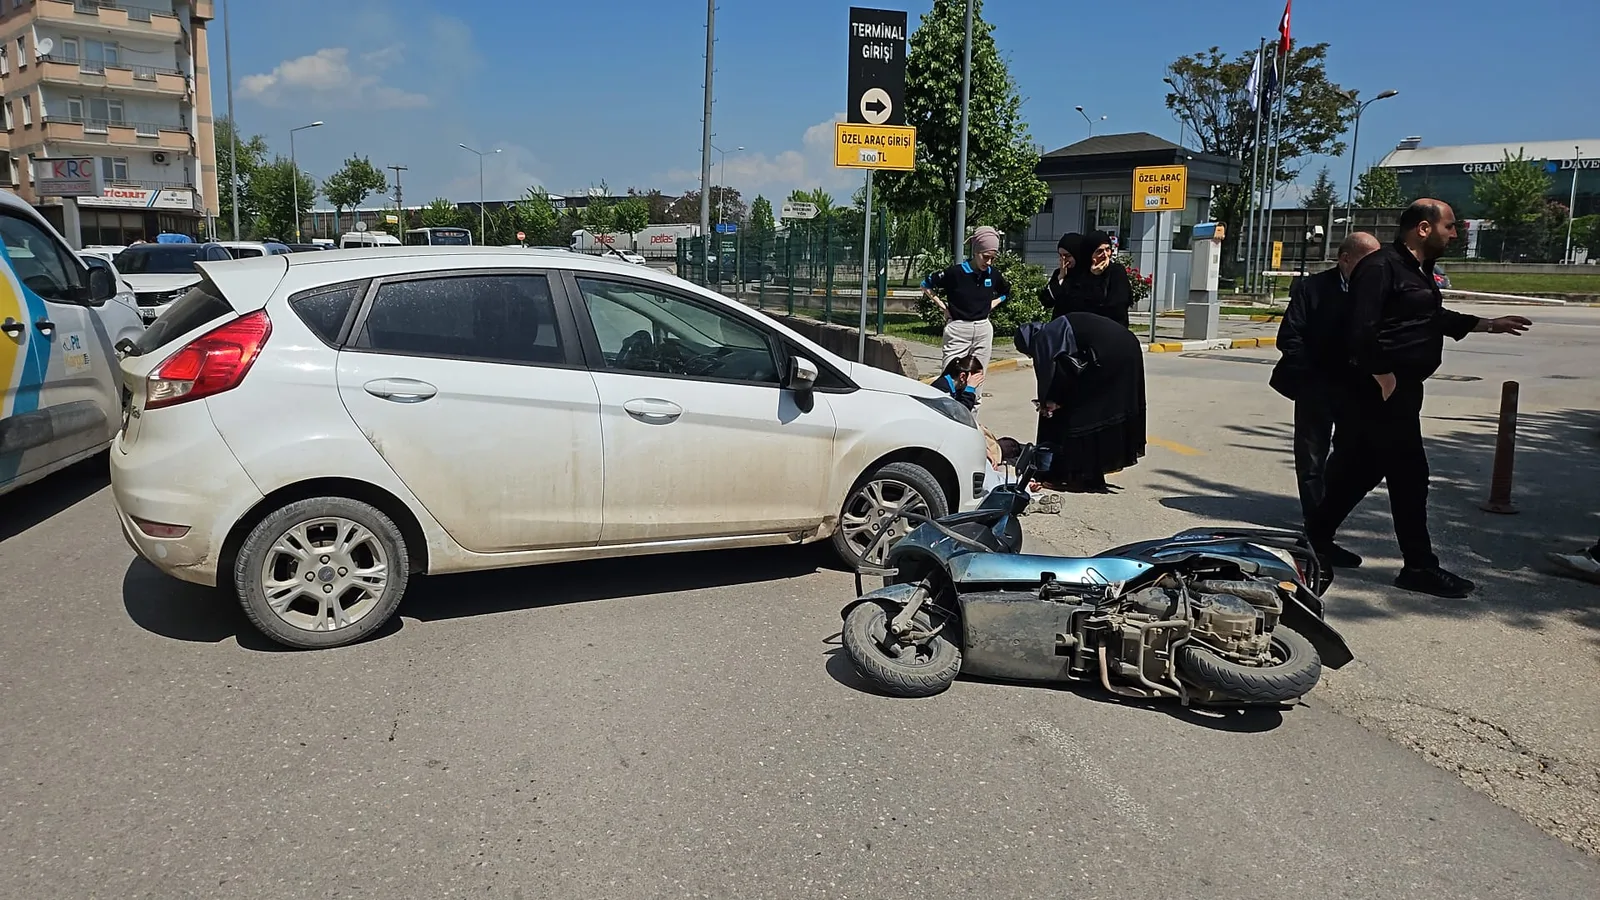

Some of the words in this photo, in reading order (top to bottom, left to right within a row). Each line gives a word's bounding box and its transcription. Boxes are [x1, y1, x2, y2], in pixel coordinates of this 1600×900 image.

[852, 22, 904, 40] TERMİNAL
[862, 42, 894, 63] GİRİŞİ
[841, 131, 862, 145] ÖZEL
[864, 134, 886, 147] ARAÇ
[887, 134, 911, 148] GİRİŞİ
[862, 153, 876, 162] 100
[877, 151, 887, 162] TL
[54, 159, 92, 178] KRC
[1462, 163, 1506, 173] GRAN
[1138, 173, 1159, 183] ÖZEL
[1160, 173, 1181, 183] ARAÇ
[1147, 183, 1171, 195] GİRİŞİ
[1160, 197, 1169, 205] TL
